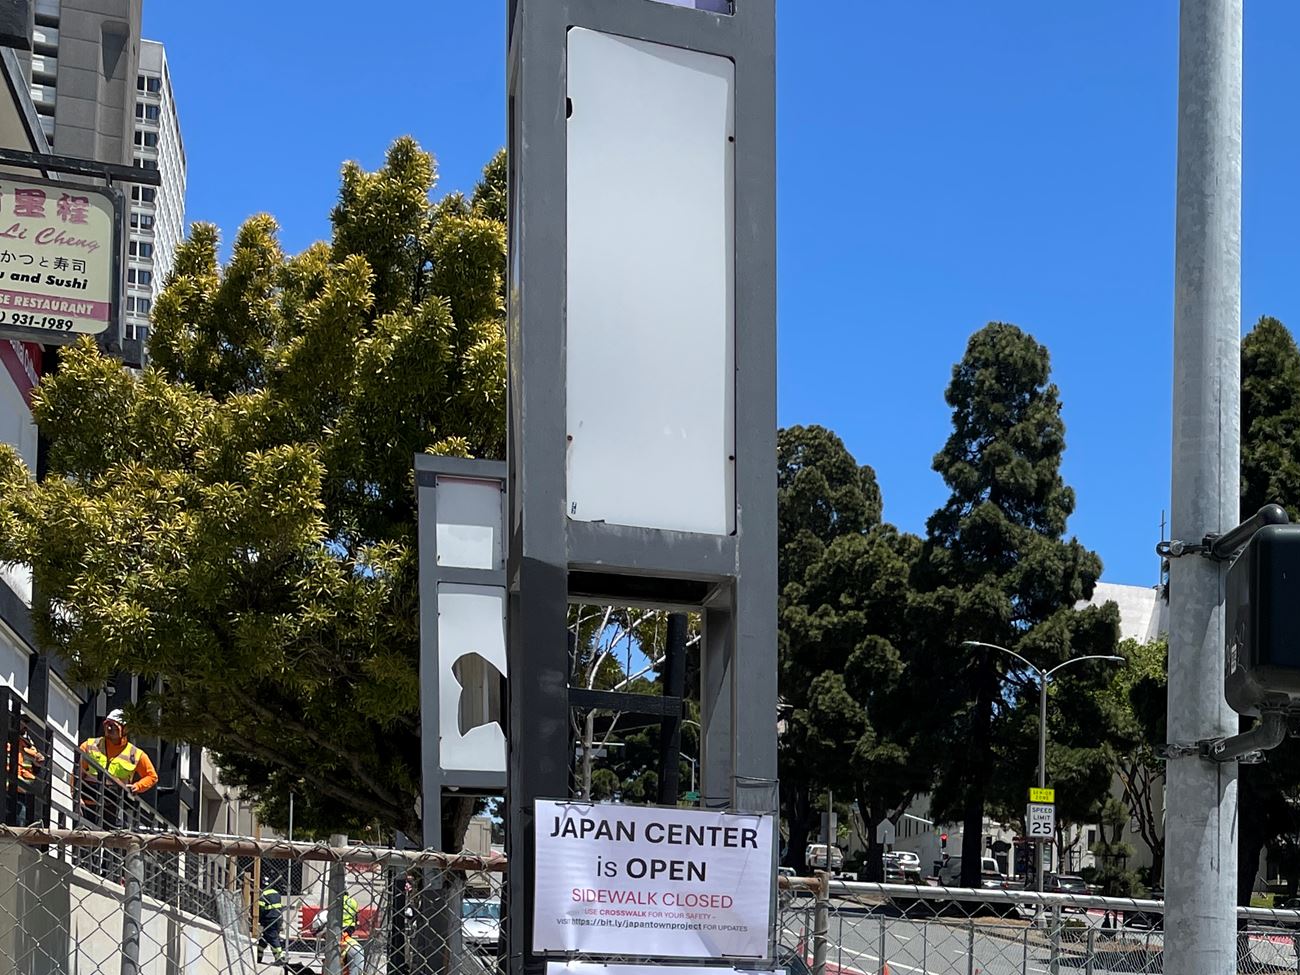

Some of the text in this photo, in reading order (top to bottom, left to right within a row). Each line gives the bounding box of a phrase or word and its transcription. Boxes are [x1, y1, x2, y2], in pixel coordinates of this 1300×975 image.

[0, 186, 89, 225] 里程
[35, 227, 100, 254] Cheng
[10, 272, 41, 284] and
[45, 275, 88, 290] Sushi
[14, 296, 94, 315] RESTAURANT
[12, 313, 74, 331] 931-1989
[550, 815, 759, 849] JAPAN CENTER
[1032, 821, 1052, 835] 25
[597, 855, 707, 883] is OPEN
[571, 887, 733, 909] SIDEWALK CLOSED
[599, 909, 647, 918] CROSSWALK
[664, 911, 684, 919] YOUR
[685, 912, 712, 920] SAFETY
[718, 924, 748, 932] UPDATES
